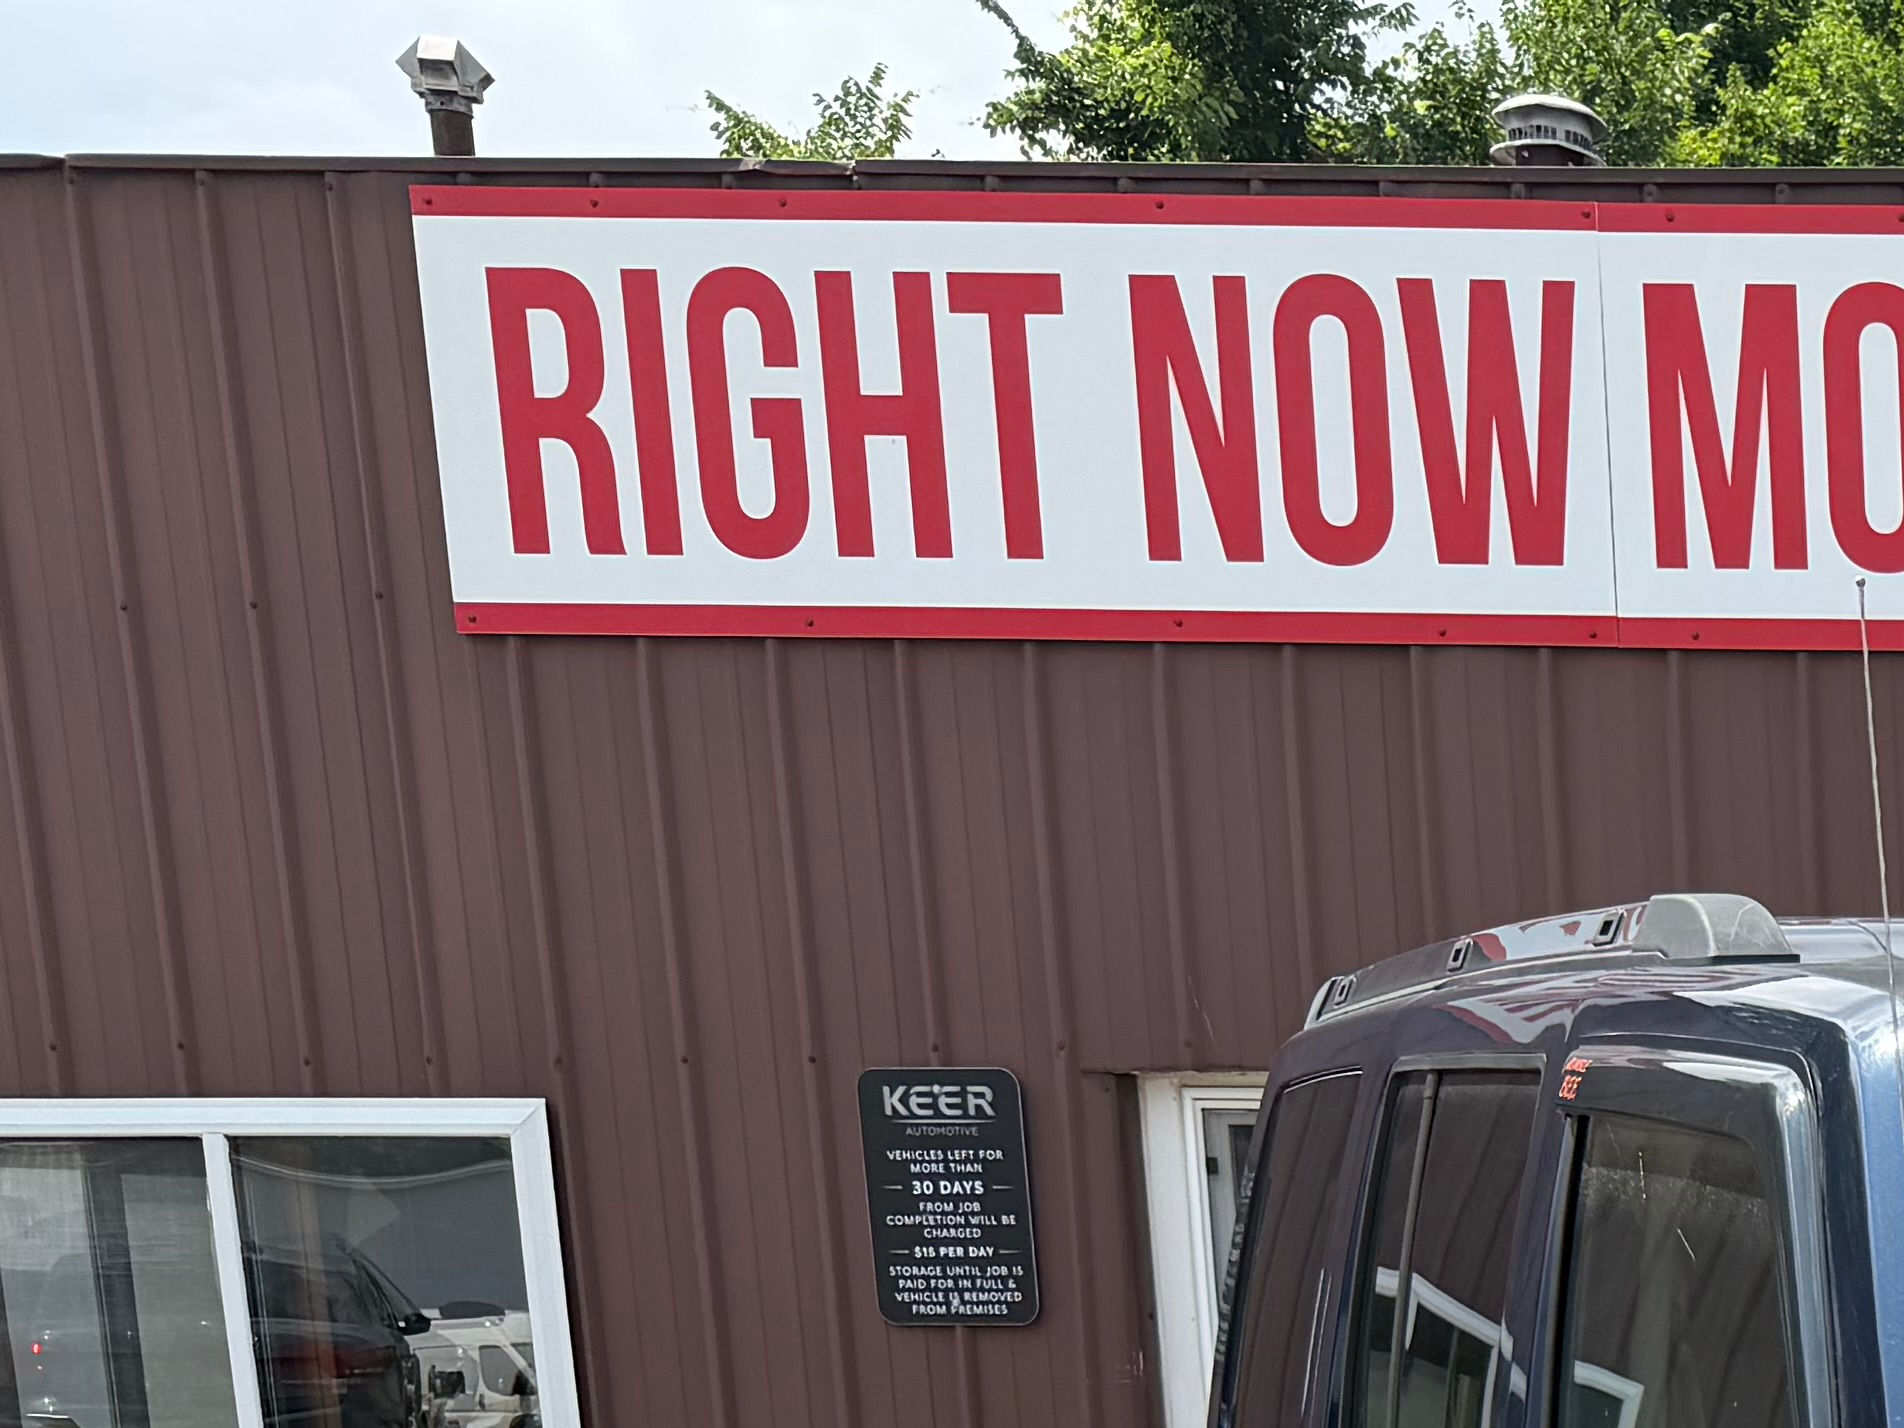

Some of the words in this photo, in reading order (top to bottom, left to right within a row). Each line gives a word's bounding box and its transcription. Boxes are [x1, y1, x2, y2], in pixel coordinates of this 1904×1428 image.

[488, 267, 1062, 559] RIGHT
[1130, 274, 1575, 566] NOW
[883, 1084, 995, 1116] KEER
[906, 1126, 978, 1136] AUTOMOTIVE
[887, 1150, 943, 1160] VEHICLES
[948, 1150, 974, 1160] LEFT
[979, 1150, 1003, 1160] FOR
[910, 1163, 945, 1173] MORE
[949, 1163, 982, 1172] THAN
[912, 1180, 933, 1194] 30
[939, 1180, 984, 1194] DAYS
[919, 1202, 953, 1212] FROM
[958, 1202, 981, 1213] JOB
[886, 1214, 965, 1225] COMPLETION
[968, 1215, 997, 1225] WILL
[1002, 1215, 1016, 1224] BE
[924, 1228, 981, 1238] CHARGED
[939, 1247, 964, 1257] PER
[969, 1246, 994, 1257] DAY
[889, 1266, 943, 1276] STORAGE
[947, 1266, 981, 1276] UNTIL
[986, 1266, 1008, 1277] JOB
[899, 1279, 926, 1289] PAID
[930, 1279, 955, 1289] FOR
[959, 1279, 972, 1288] IN
[976, 1279, 1003, 1289] FULL
[895, 1292, 945, 1302] VEHICLE
[964, 1292, 1022, 1302] REMOVED
[912, 1305, 947, 1314] FROM
[951, 1304, 1007, 1314] PREMISES
